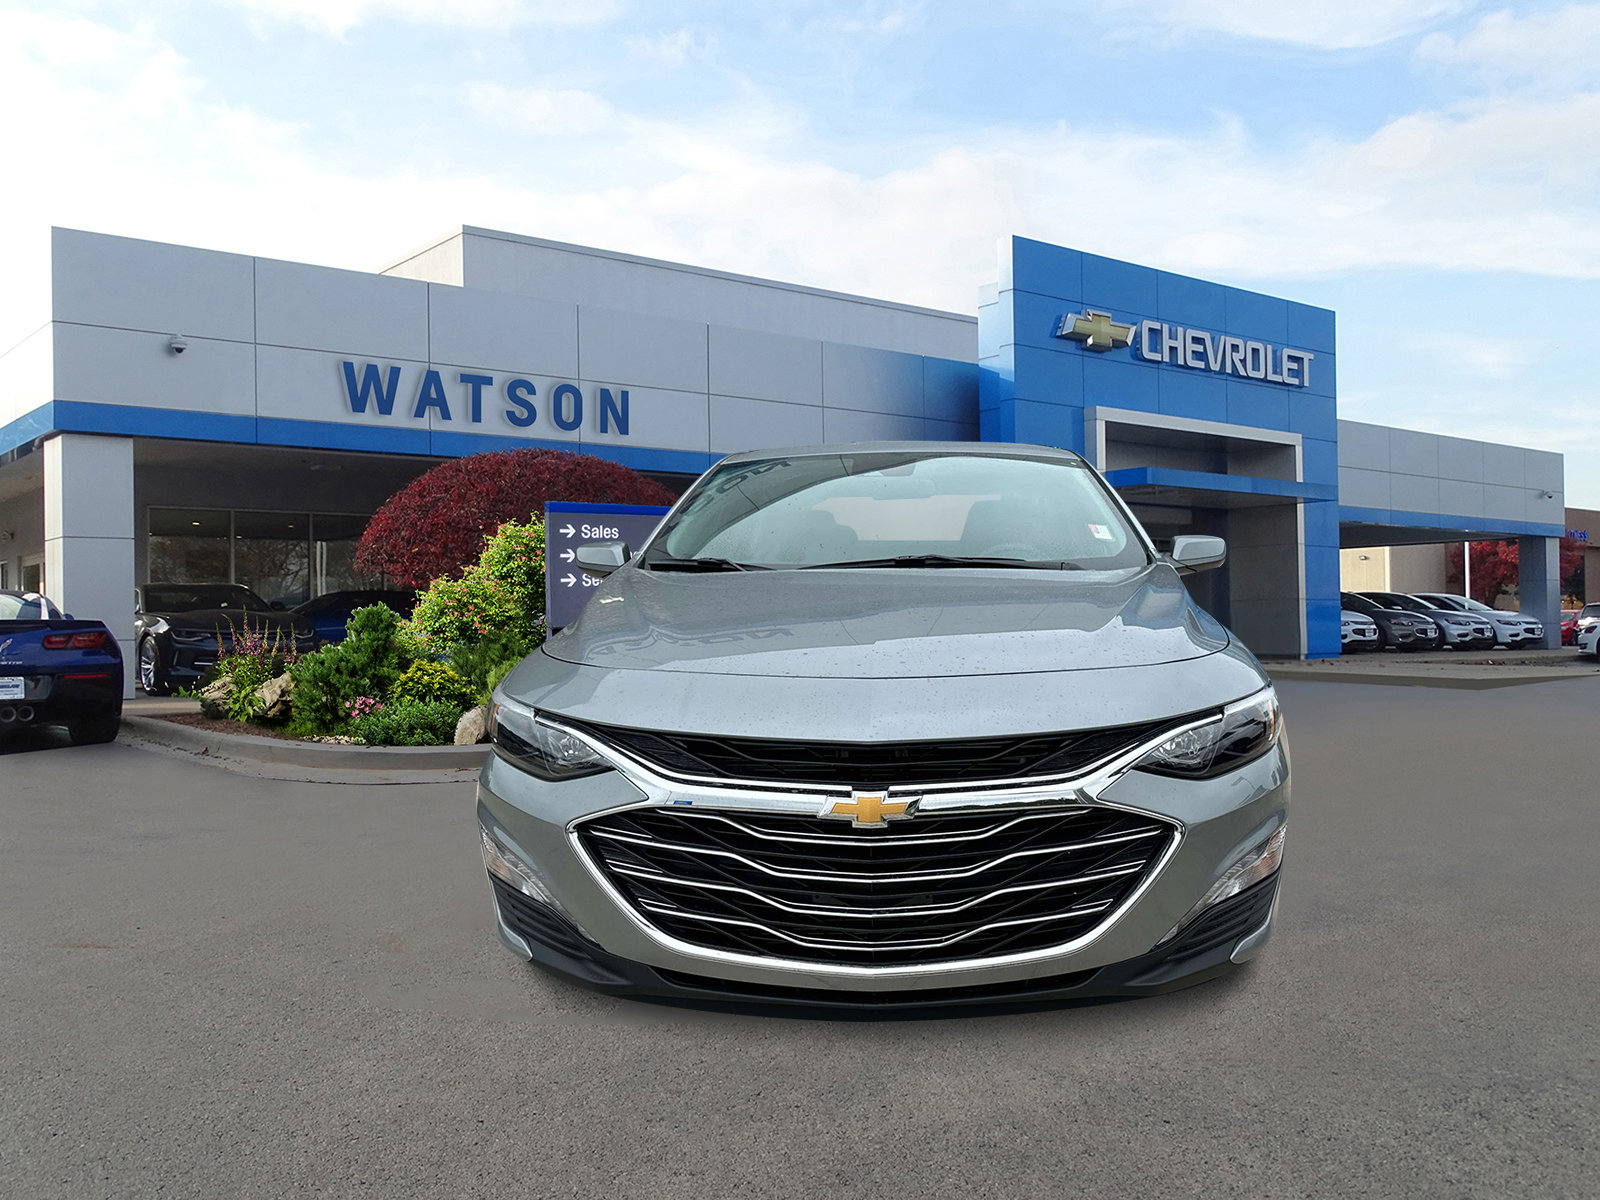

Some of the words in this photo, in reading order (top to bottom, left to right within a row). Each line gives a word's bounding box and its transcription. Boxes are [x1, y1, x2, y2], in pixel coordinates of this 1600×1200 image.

[1140, 319, 1314, 387] CHEVROLET
[341, 360, 630, 436] WATSON
[581, 524, 620, 539] Sales
